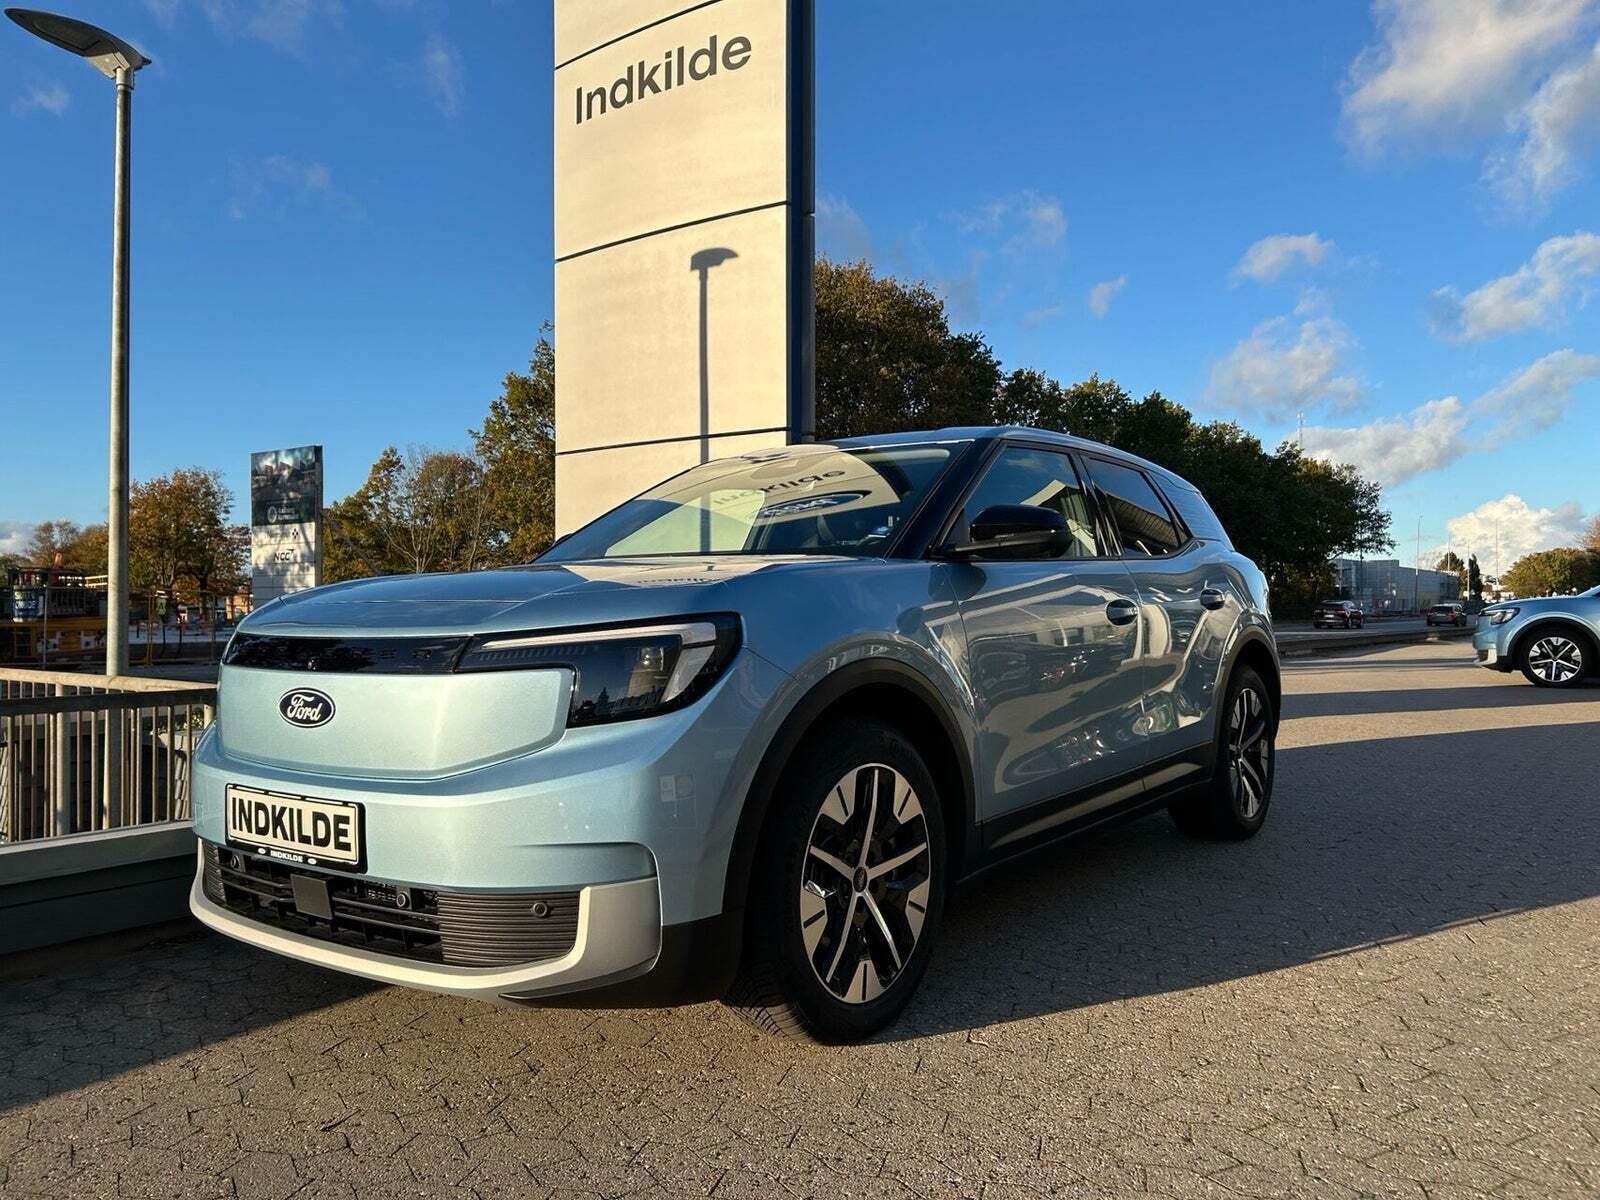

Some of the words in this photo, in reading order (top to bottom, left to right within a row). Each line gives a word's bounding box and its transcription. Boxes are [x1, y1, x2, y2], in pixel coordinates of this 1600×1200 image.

[576, 34, 752, 125] Indkilde
[273, 552, 290, 562] NCC
[287, 693, 323, 721] Ford
[232, 797, 352, 851] INDKILDE
[270, 850, 303, 863] INDKILDE
